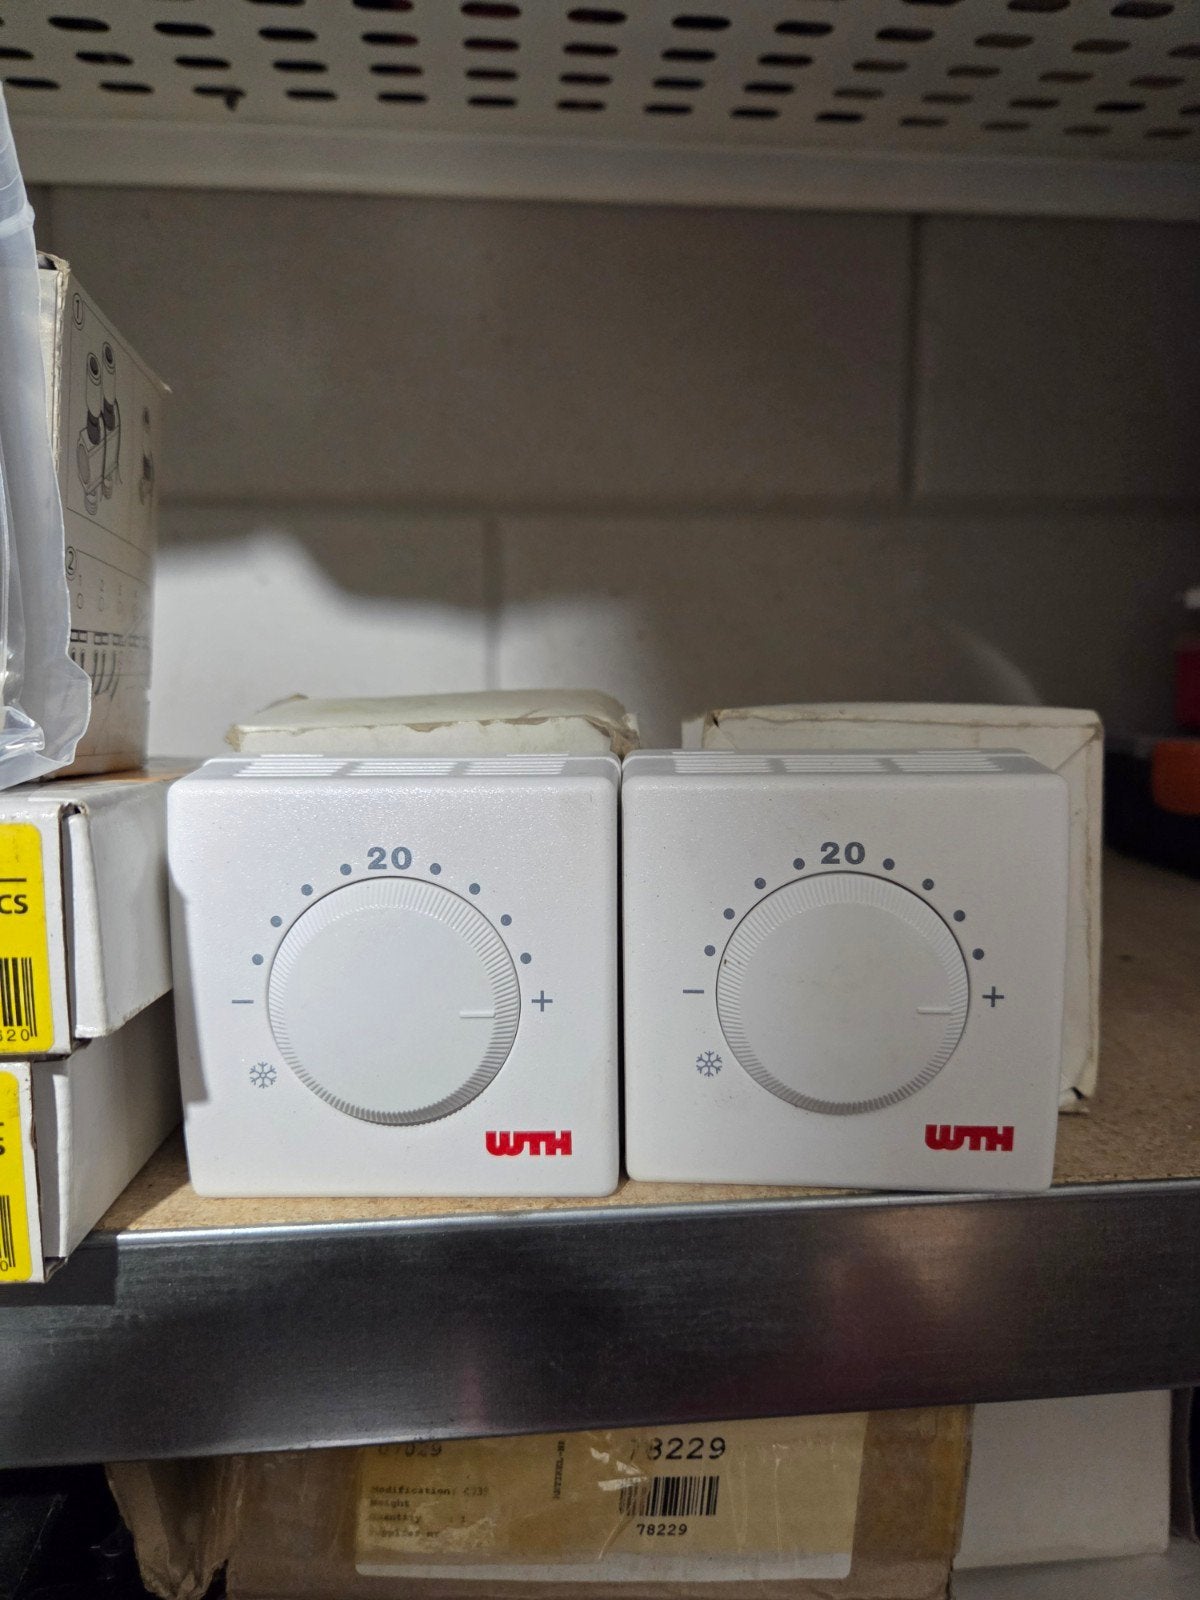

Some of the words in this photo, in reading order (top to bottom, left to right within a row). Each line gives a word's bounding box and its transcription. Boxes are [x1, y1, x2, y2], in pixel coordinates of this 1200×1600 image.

[366, 845, 413, 870] 20
[820, 841, 866, 865] 20
[485, 1130, 573, 1157] WTH
[924, 1124, 1015, 1151] WTH
[629, 1436, 727, 1461] 78229
[636, 1523, 688, 1537] 78229
